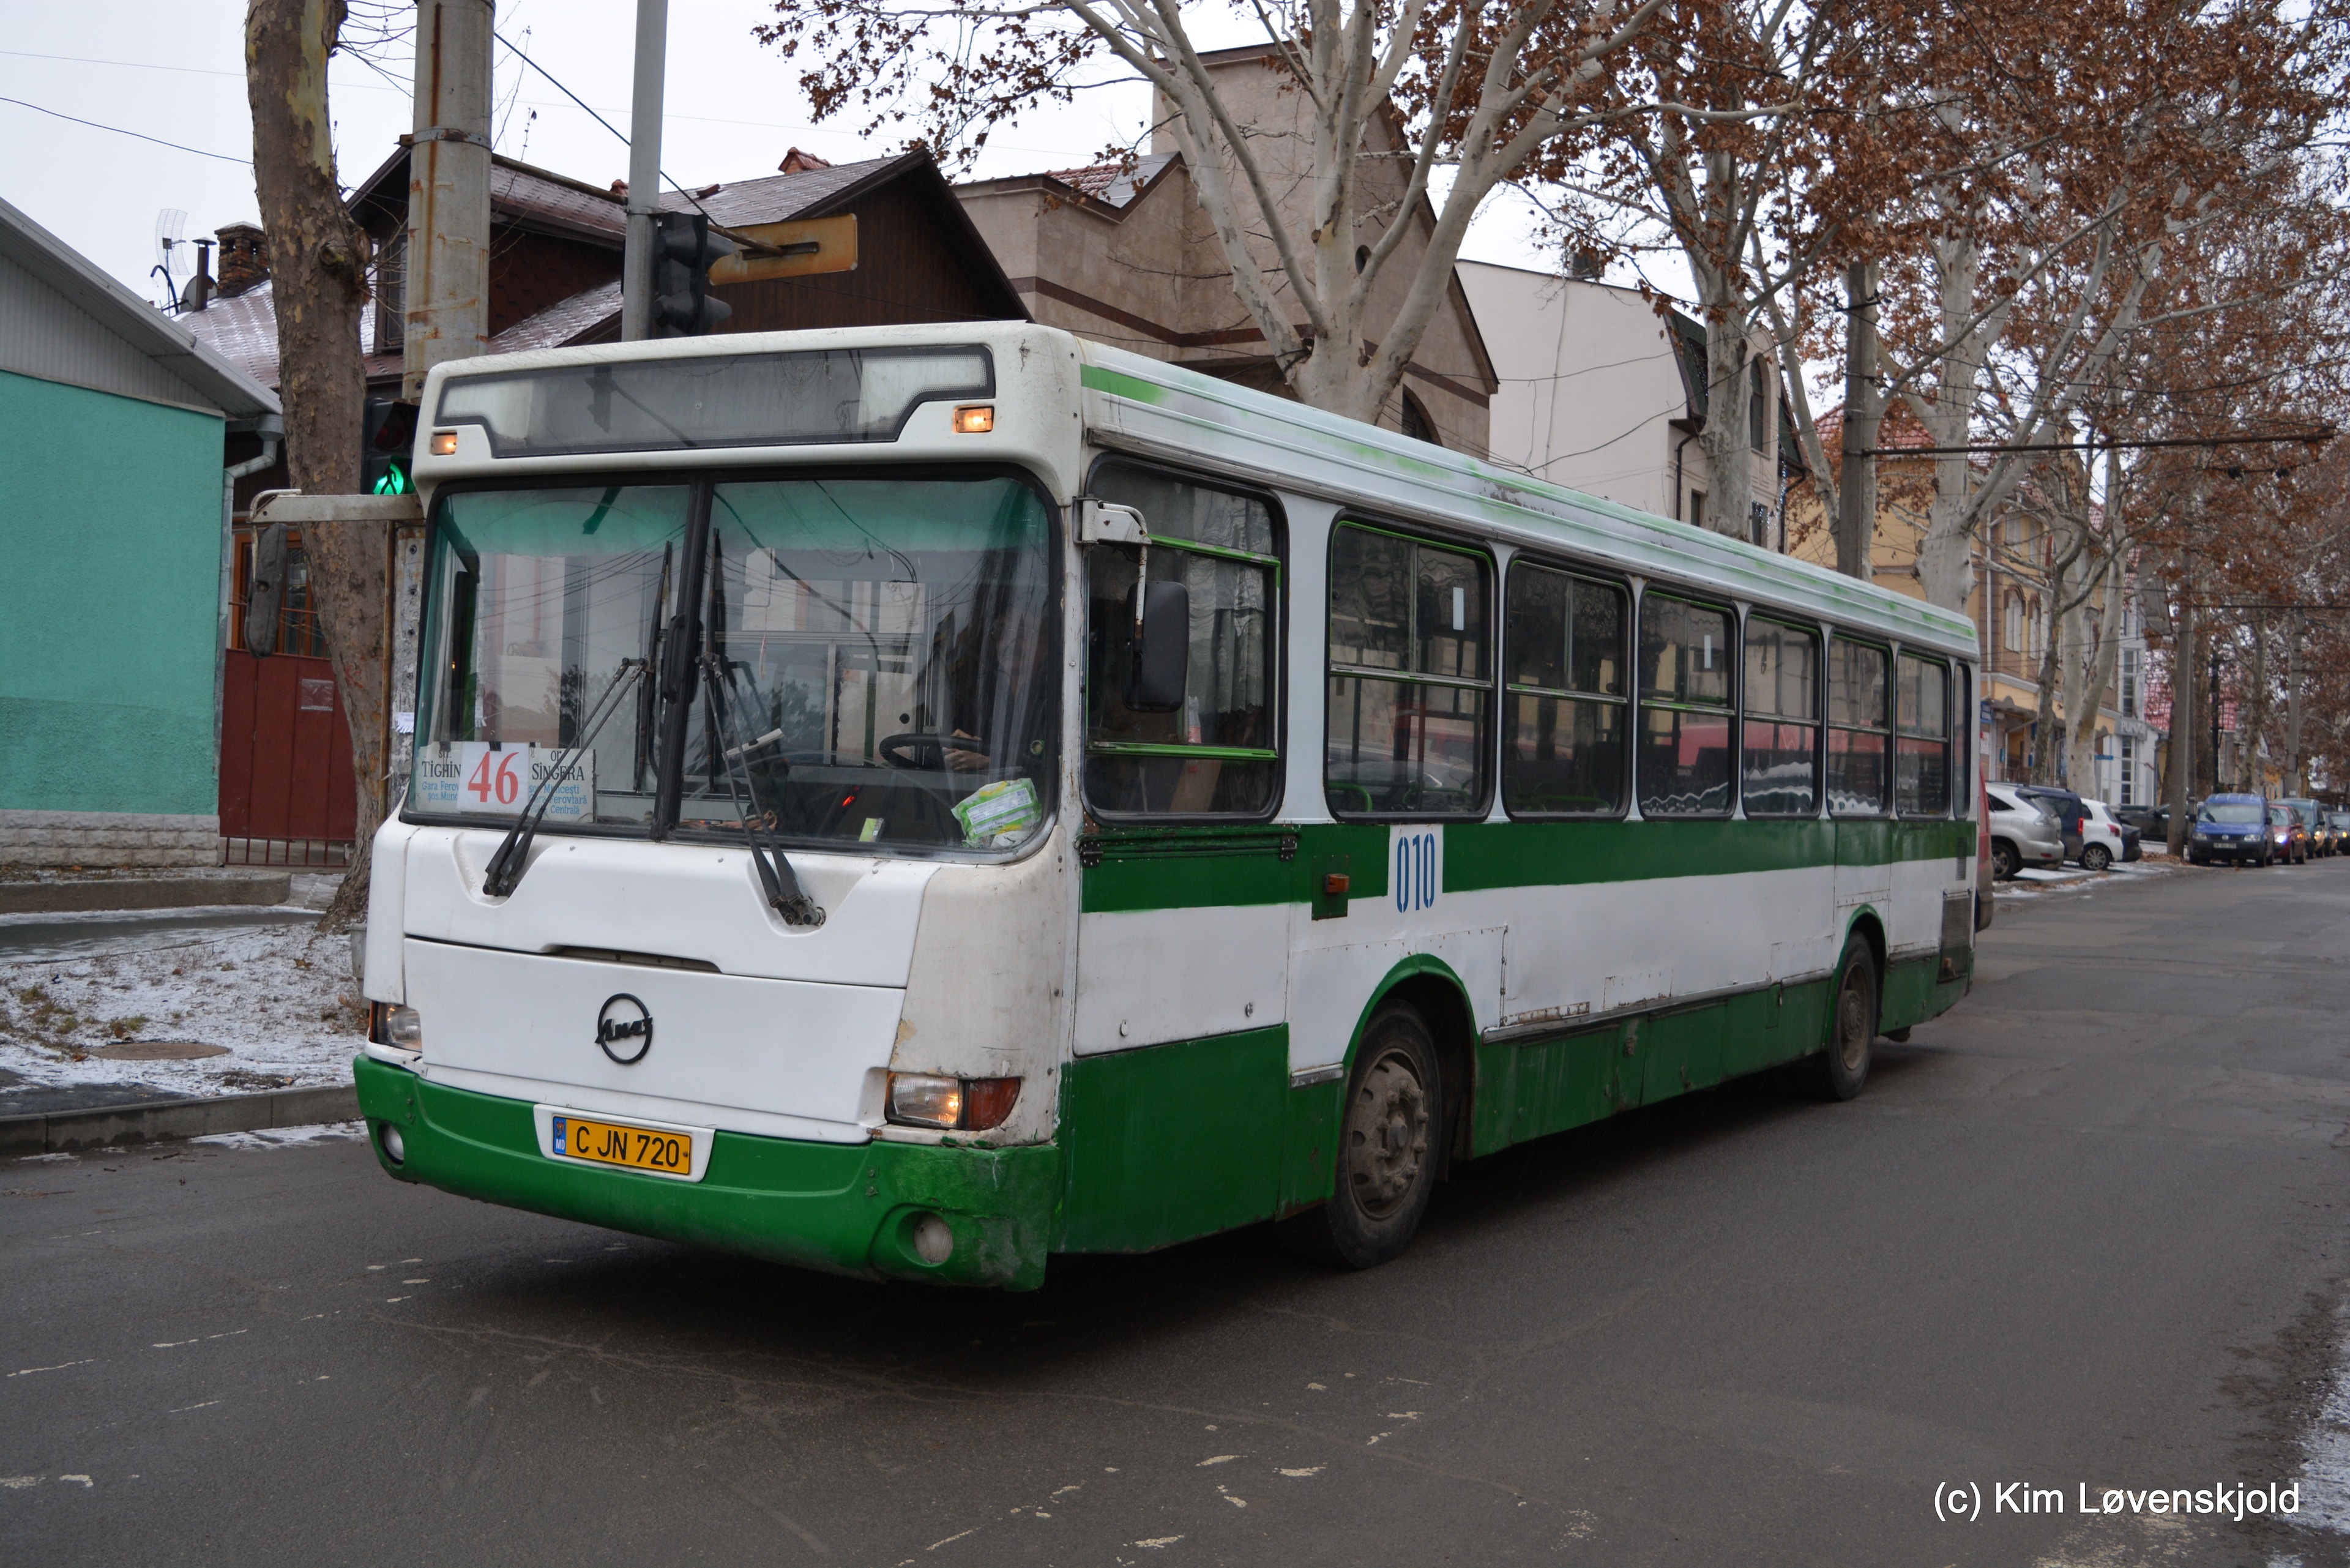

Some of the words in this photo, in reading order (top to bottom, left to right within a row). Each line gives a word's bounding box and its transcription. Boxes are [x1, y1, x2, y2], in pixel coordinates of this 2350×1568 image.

[422, 781, 438, 791] Gara
[468, 751, 519, 804] 46
[1397, 832, 1435, 914] 010
[556, 1138, 565, 1150] MD
[576, 1126, 590, 1154] C
[597, 1129, 628, 1160] JN
[636, 1134, 680, 1168] 720
